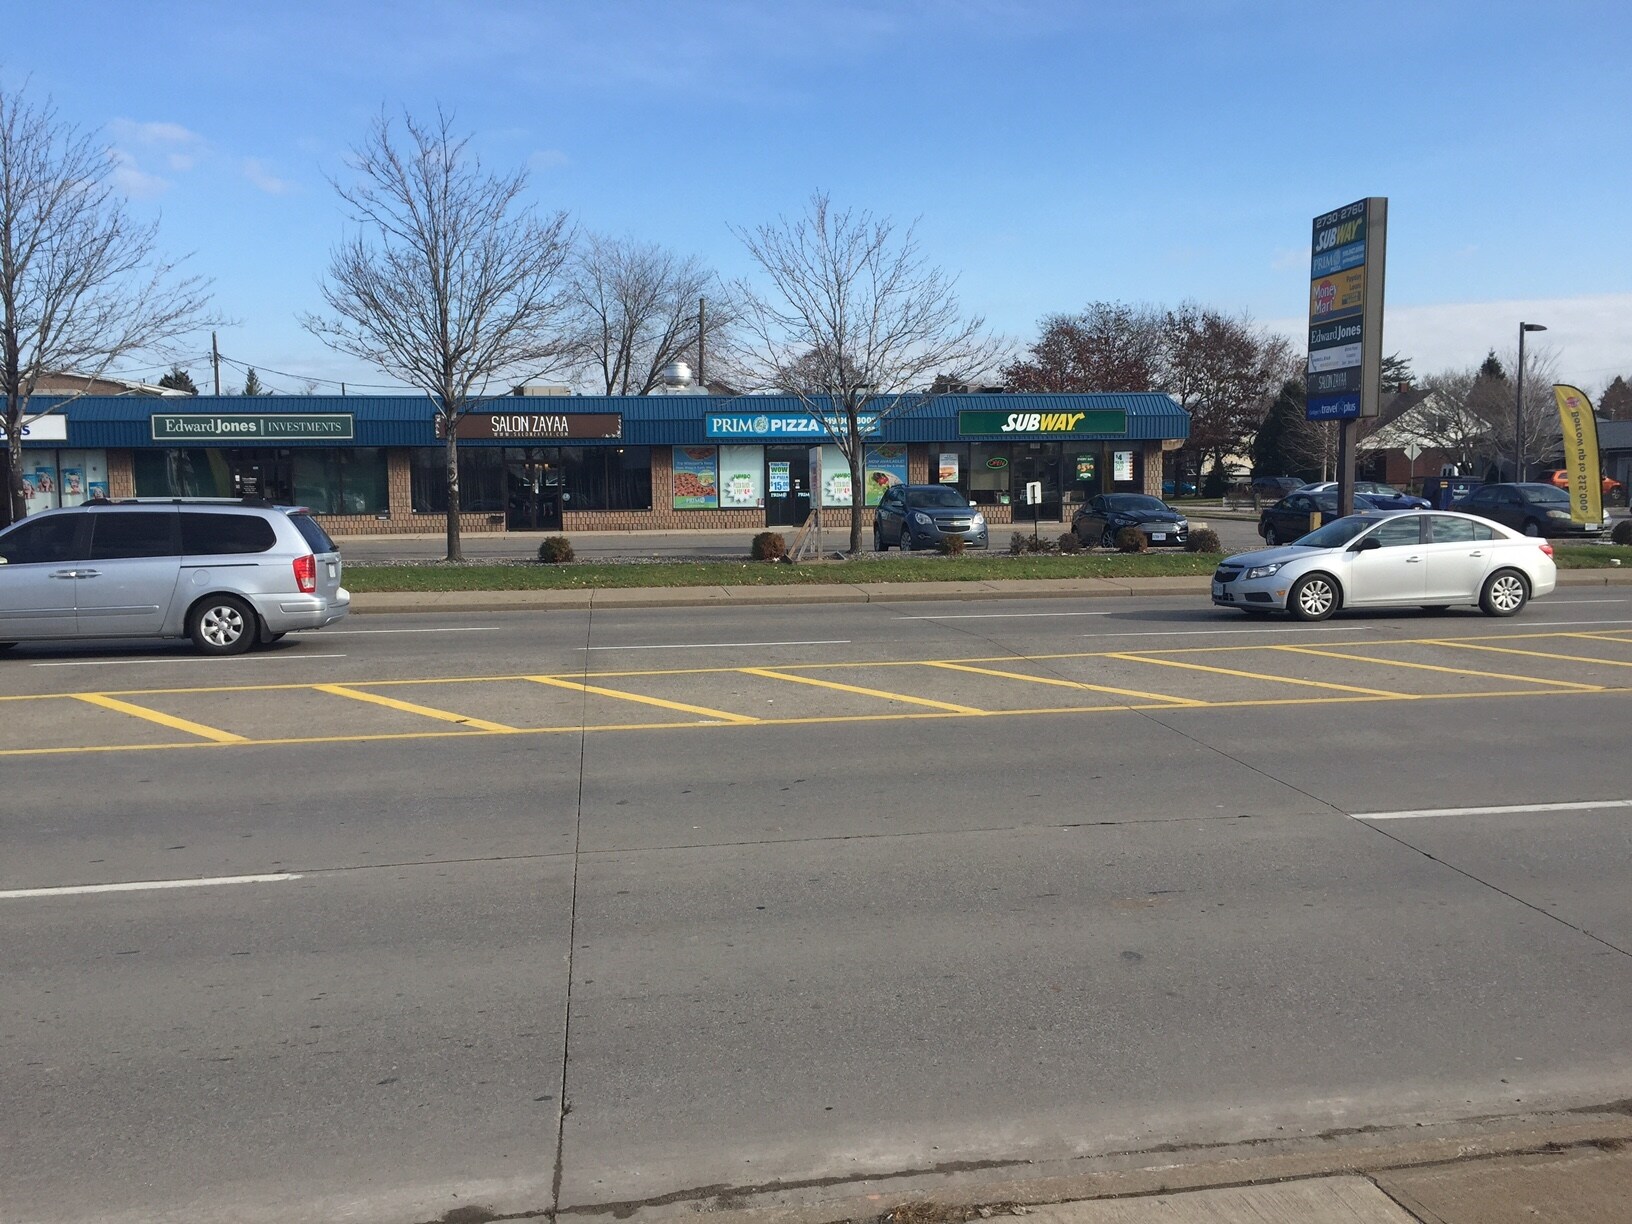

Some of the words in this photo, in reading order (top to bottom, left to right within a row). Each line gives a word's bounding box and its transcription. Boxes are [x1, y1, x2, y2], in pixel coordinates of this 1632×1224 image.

[1316, 216, 1363, 252] SUBWAY
[1313, 285, 1336, 300] Money
[1315, 299, 1333, 315] Mart
[1321, 402, 1338, 414] travel
[1343, 402, 1356, 414] plus
[268, 421, 342, 432] INVESTMENTS
[491, 416, 529, 432] SALON
[532, 416, 569, 432] ZAYAA
[771, 419, 819, 432] PIZZA
[1001, 412, 1085, 432] SUBWAY
